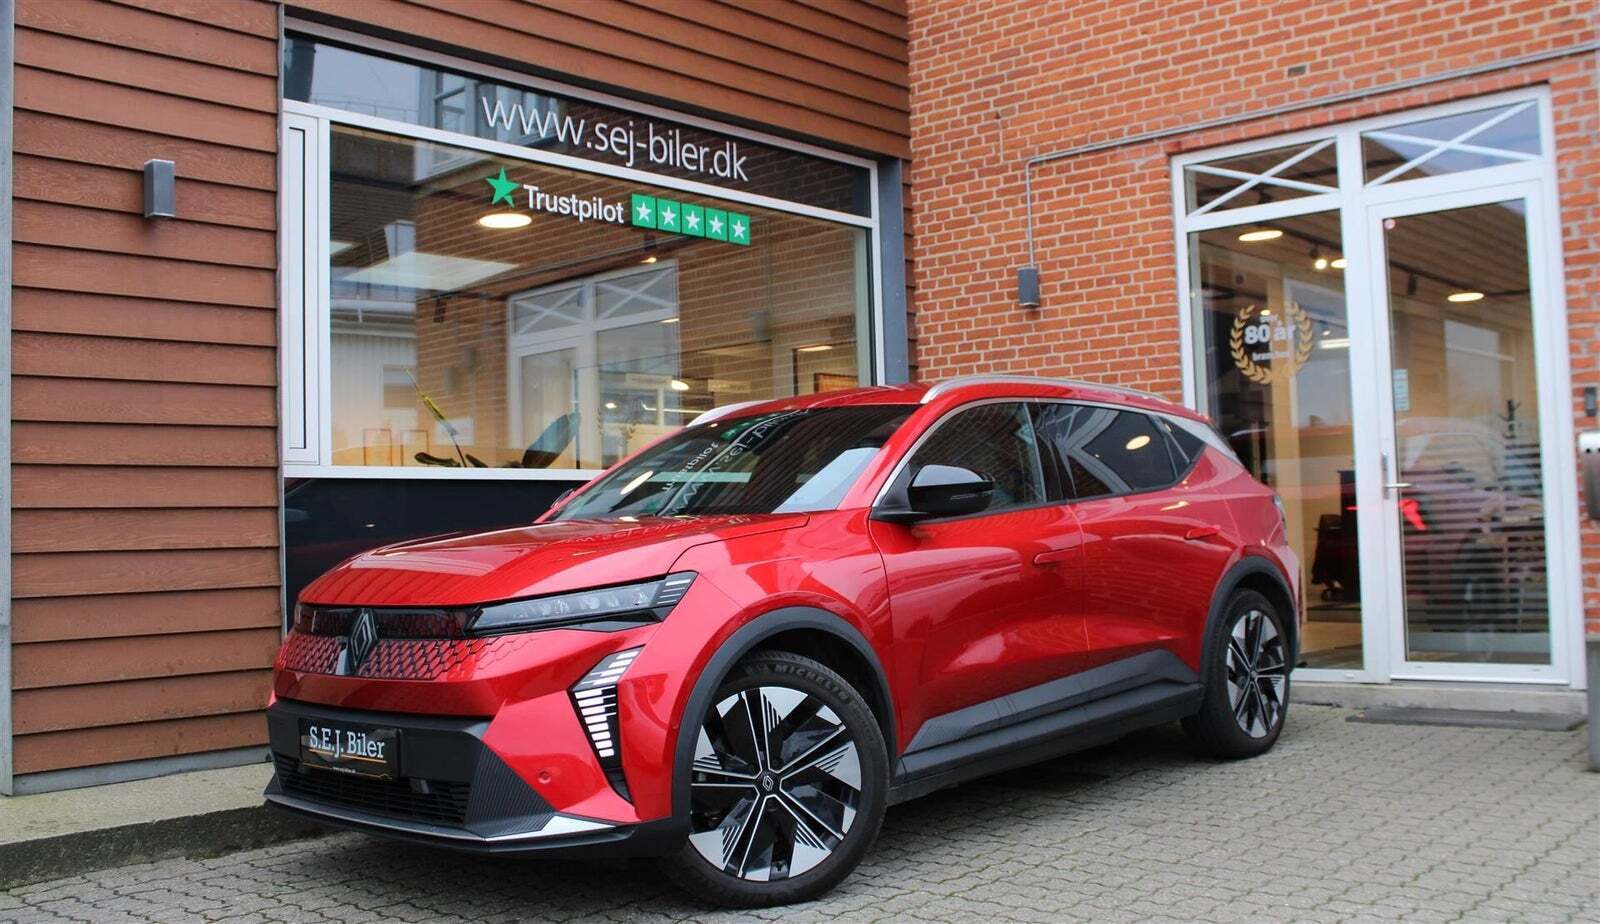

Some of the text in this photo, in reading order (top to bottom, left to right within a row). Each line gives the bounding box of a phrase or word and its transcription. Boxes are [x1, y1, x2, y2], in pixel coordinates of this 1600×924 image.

[481, 95, 749, 183] www.sej-biler.dk
[523, 183, 625, 225] Trustpilot
[1244, 324, 1270, 344] 80
[774, 664, 855, 705] MICHELIN
[309, 726, 385, 758] S.E.J. Biler
